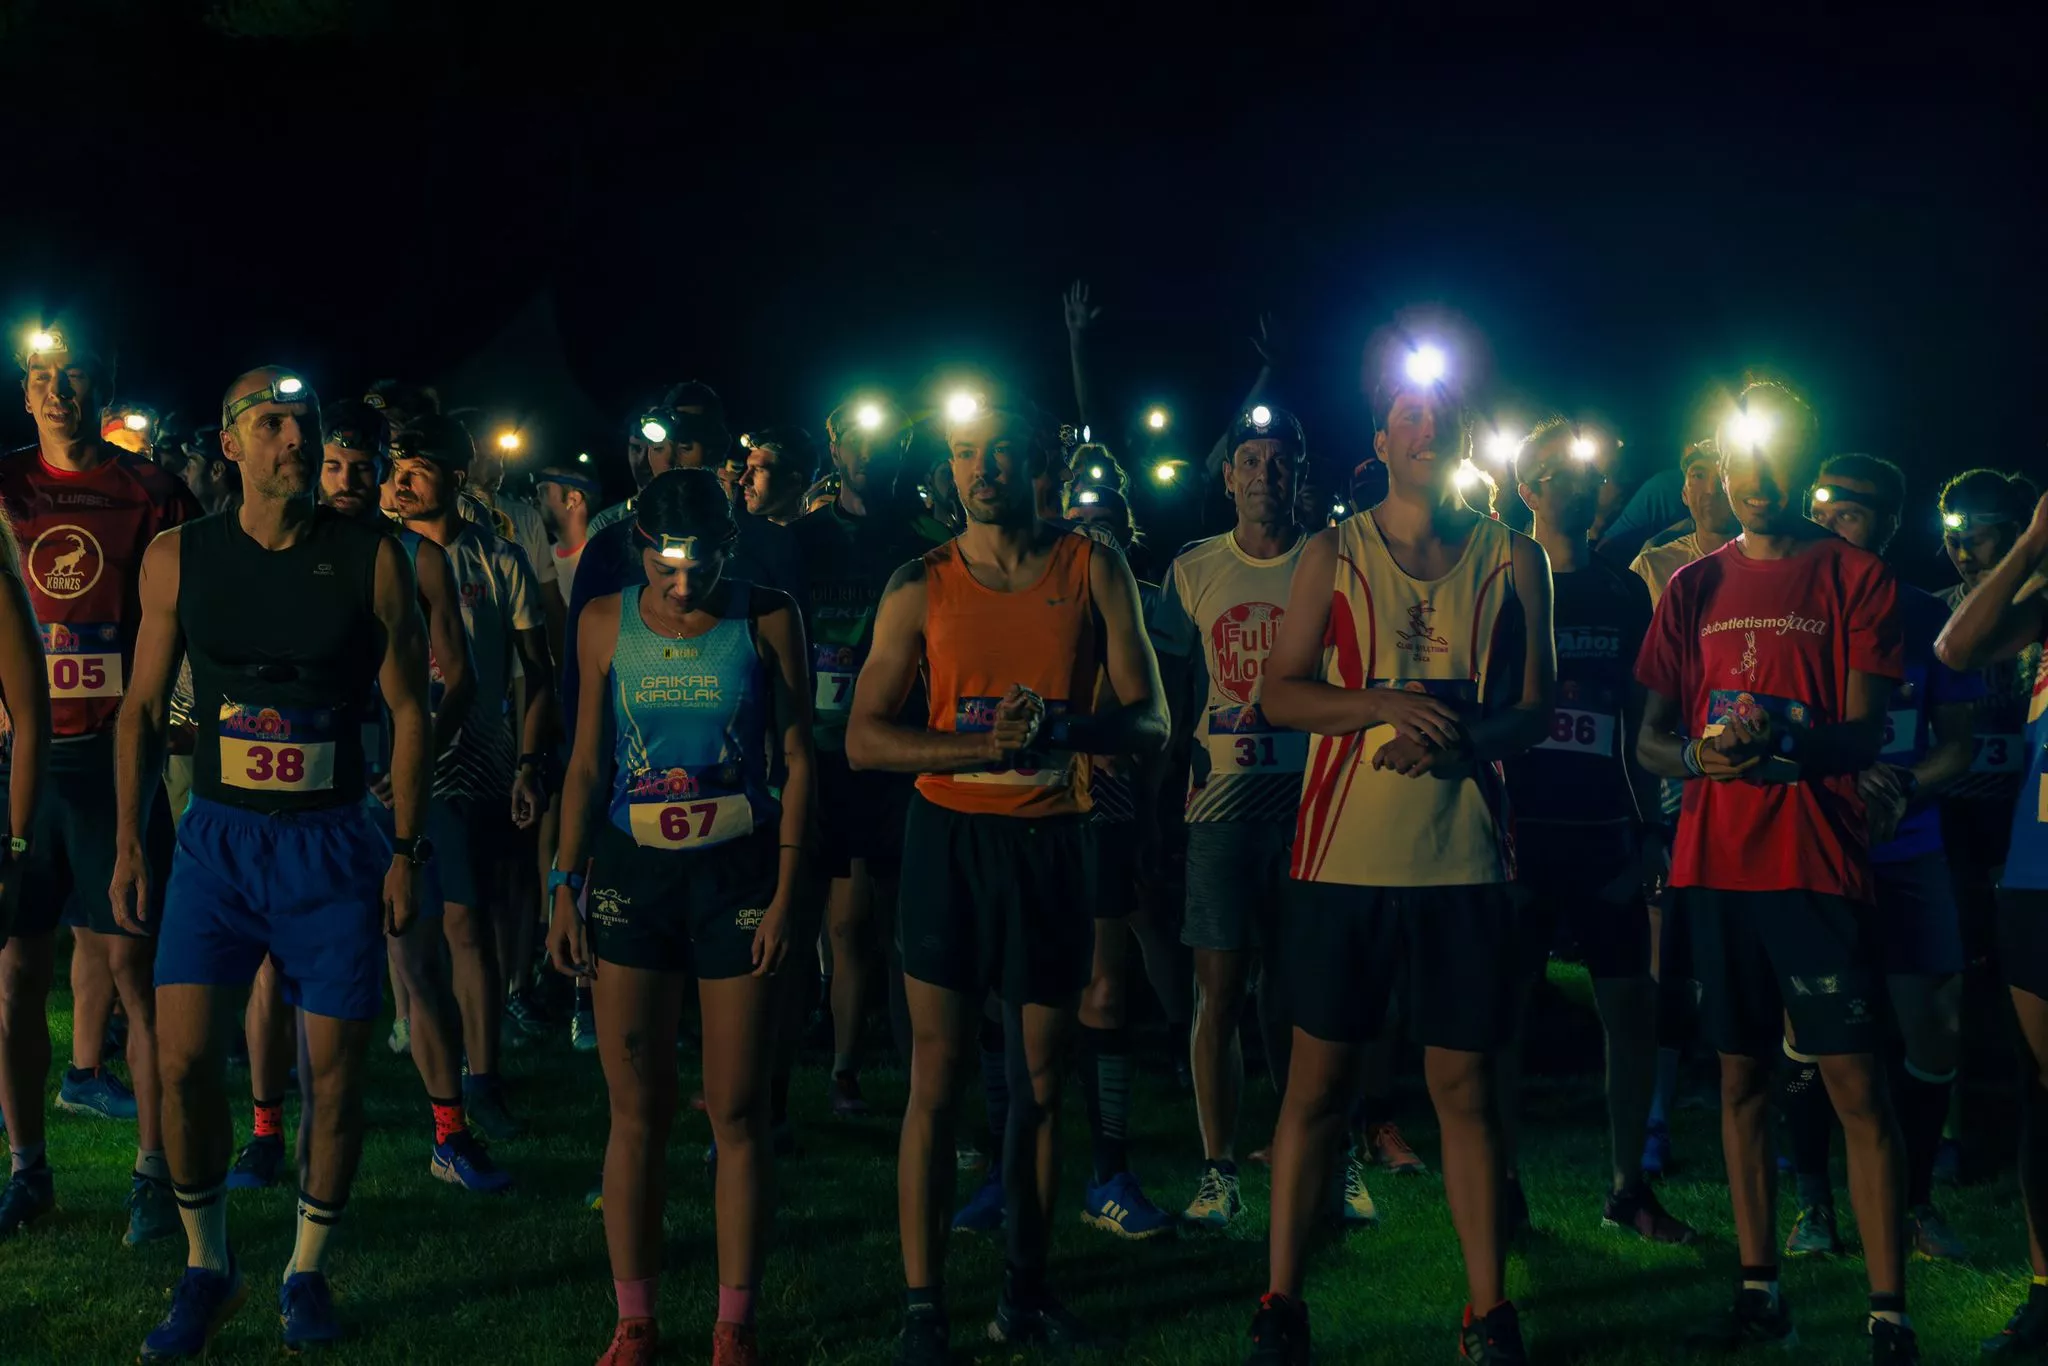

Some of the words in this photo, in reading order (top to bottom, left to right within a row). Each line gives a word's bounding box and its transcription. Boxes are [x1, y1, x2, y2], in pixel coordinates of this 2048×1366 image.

[47, 576, 81, 591] KBRNZS
[635, 689, 723, 704] KIROLAK
[246, 745, 305, 783] 38
[1234, 737, 1278, 767] 31
[660, 802, 718, 841] 67
